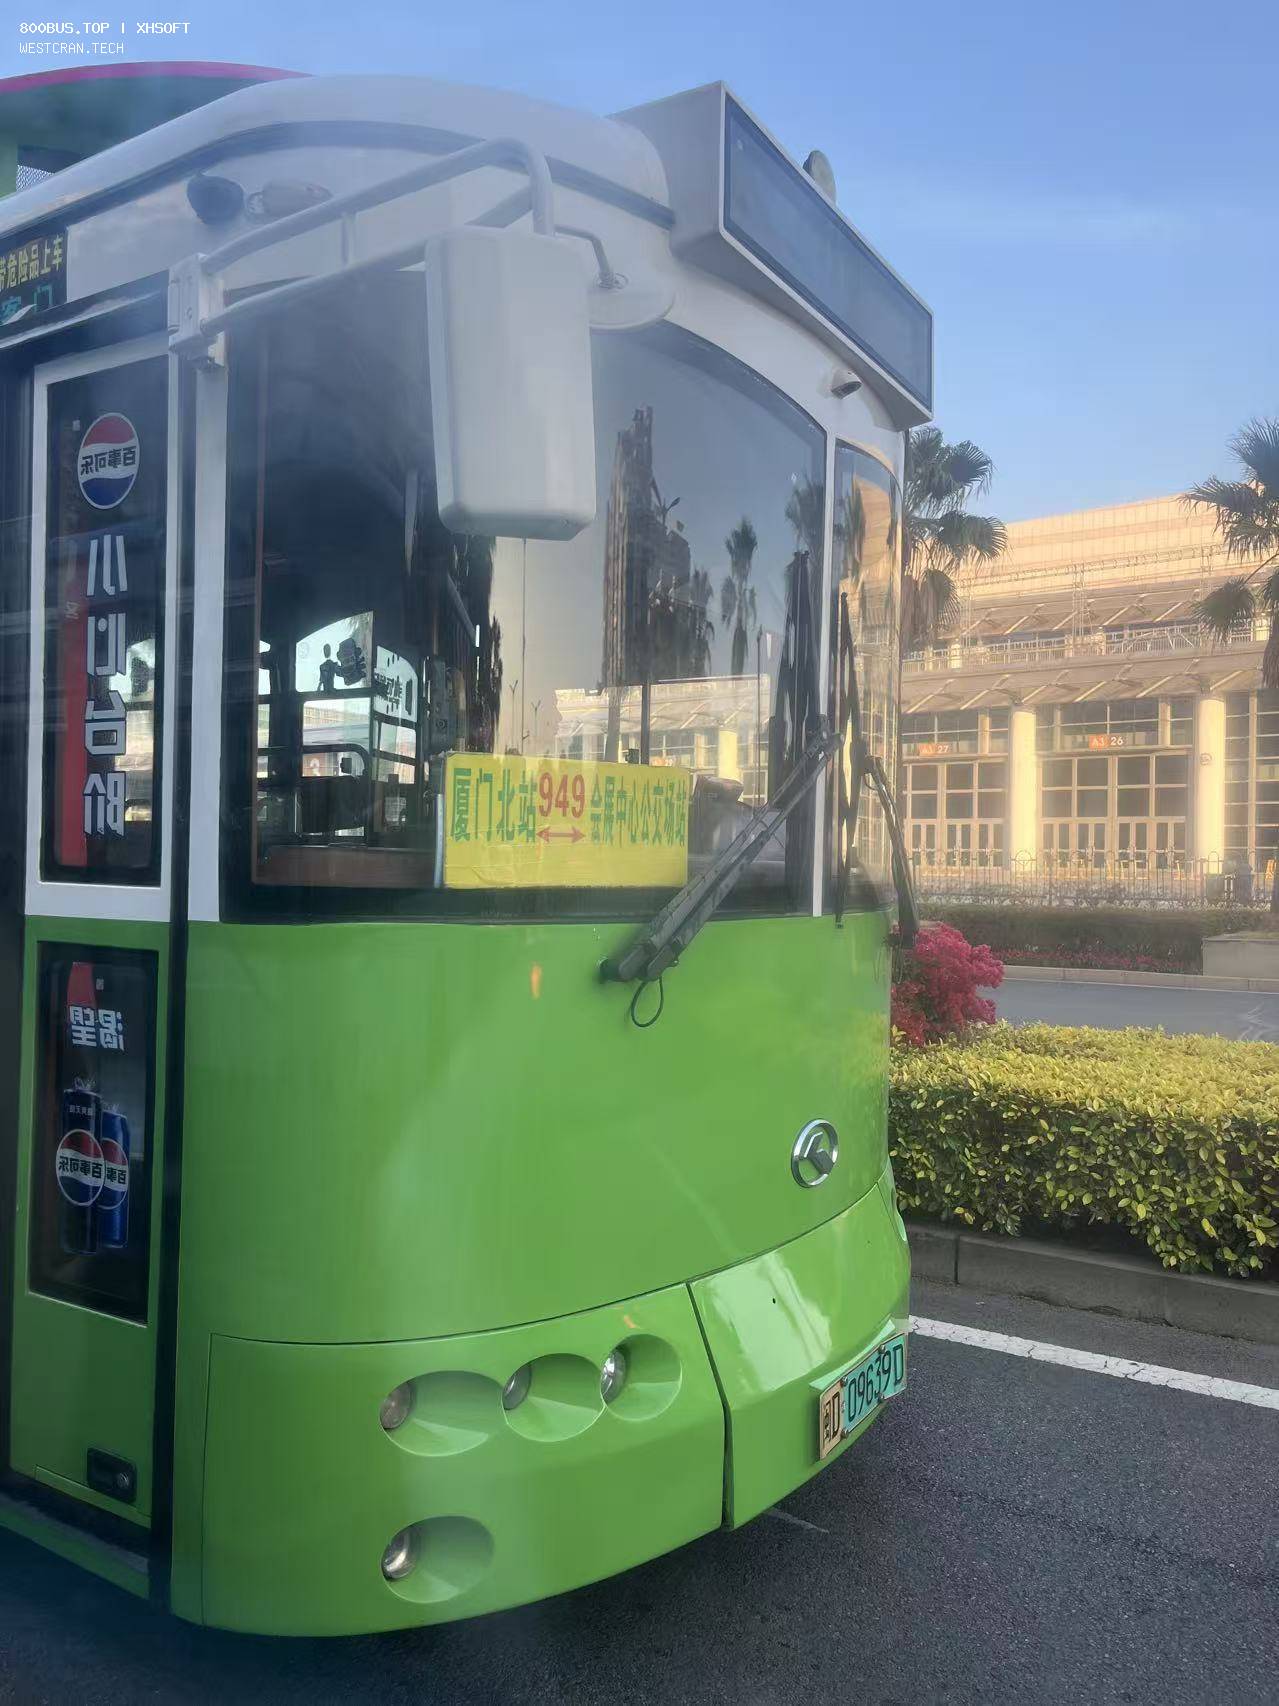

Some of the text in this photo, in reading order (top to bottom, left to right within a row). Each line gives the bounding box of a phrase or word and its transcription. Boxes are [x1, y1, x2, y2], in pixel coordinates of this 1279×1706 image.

[1110, 736, 1123, 746] 26
[937, 745, 949, 753] 27
[451, 767, 537, 843] 厦门北站
[538, 772, 585, 818] 949
